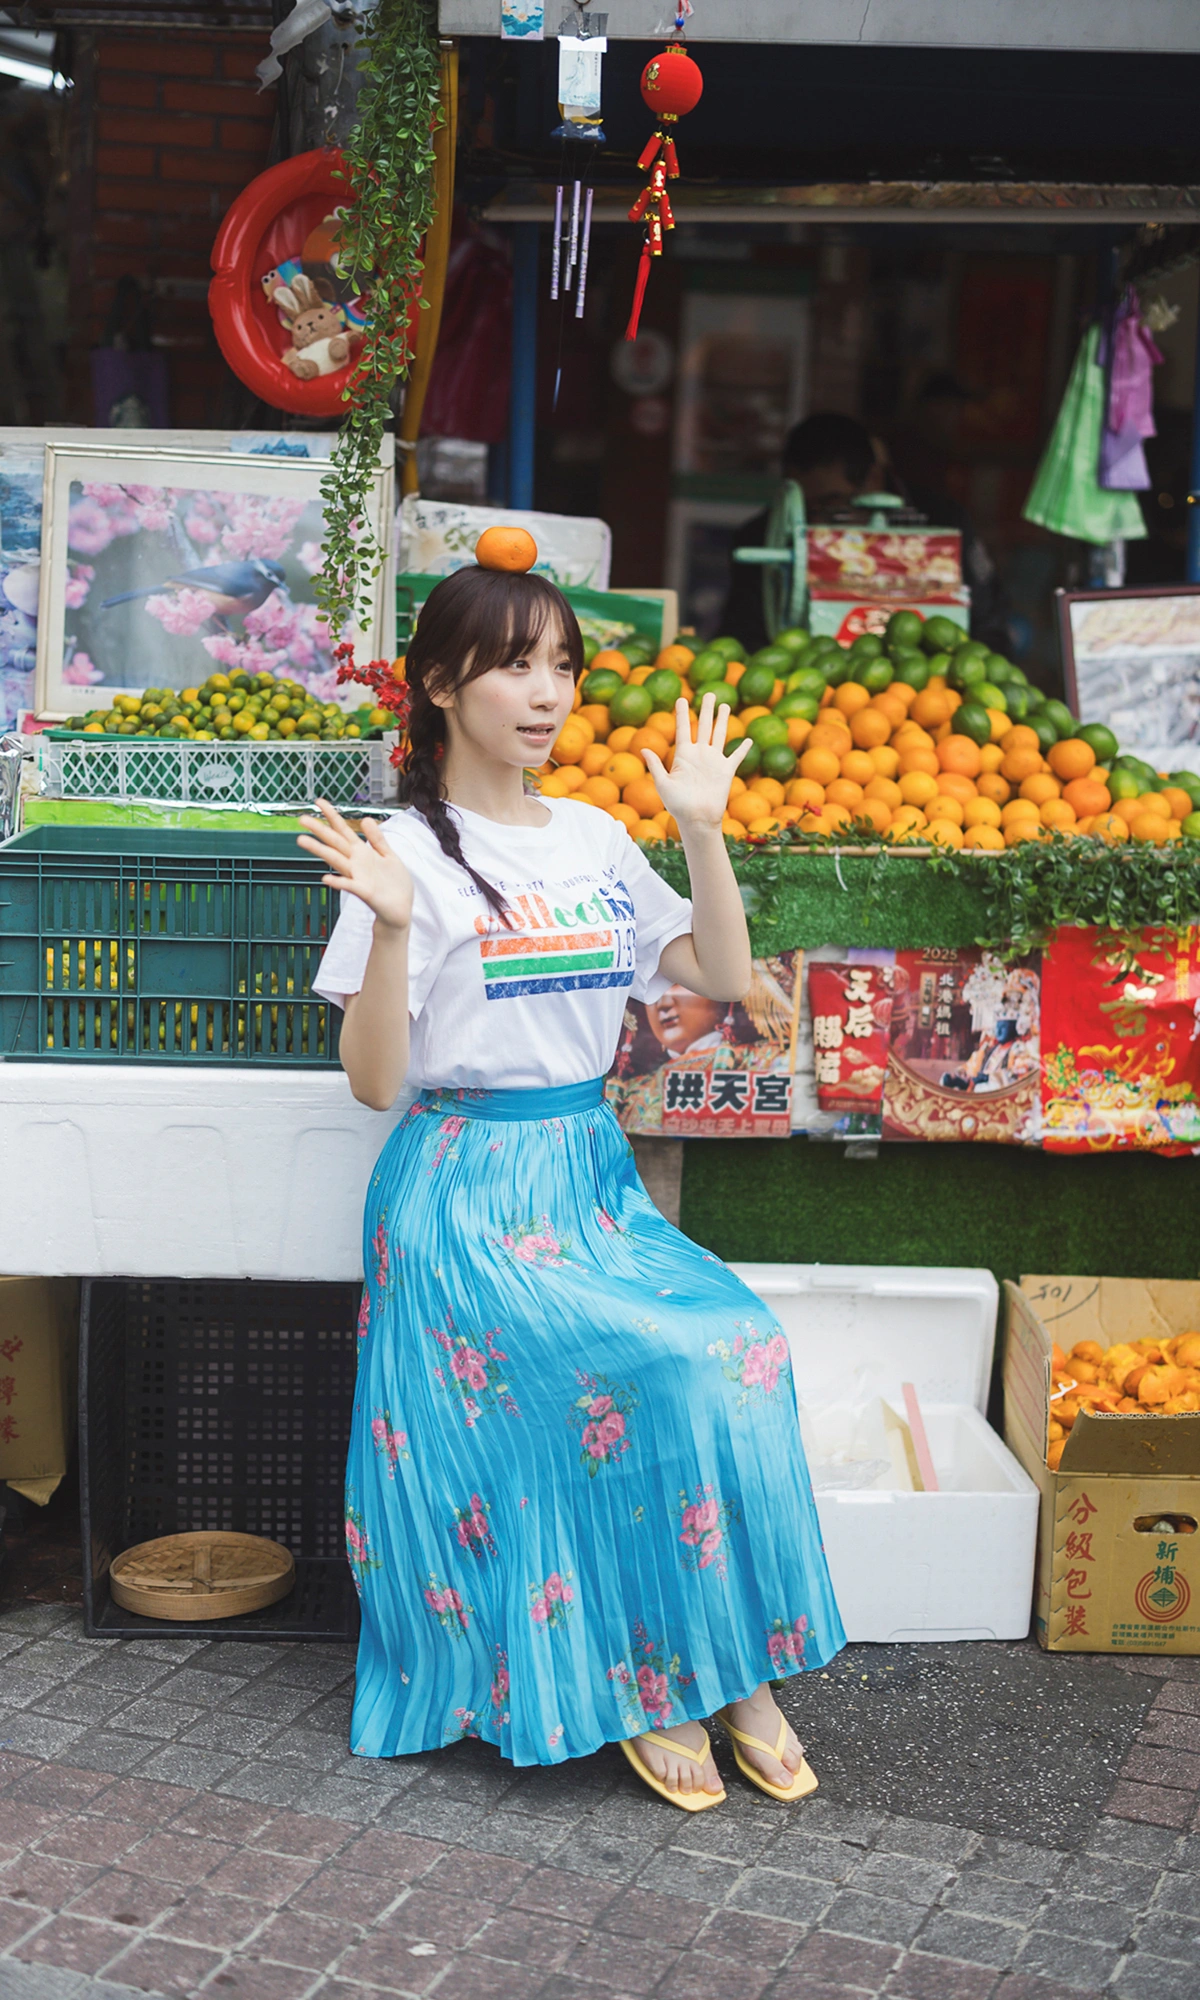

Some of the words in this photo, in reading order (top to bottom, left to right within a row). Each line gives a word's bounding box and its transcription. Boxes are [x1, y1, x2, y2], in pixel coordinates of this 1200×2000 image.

[922, 947, 958, 961] 2025
[843, 969, 876, 1039] 天后
[665, 1070, 792, 1114] 拱天宮
[1062, 1492, 1098, 1637] 分級包裝
[1153, 1540, 1179, 1585] 新埔
